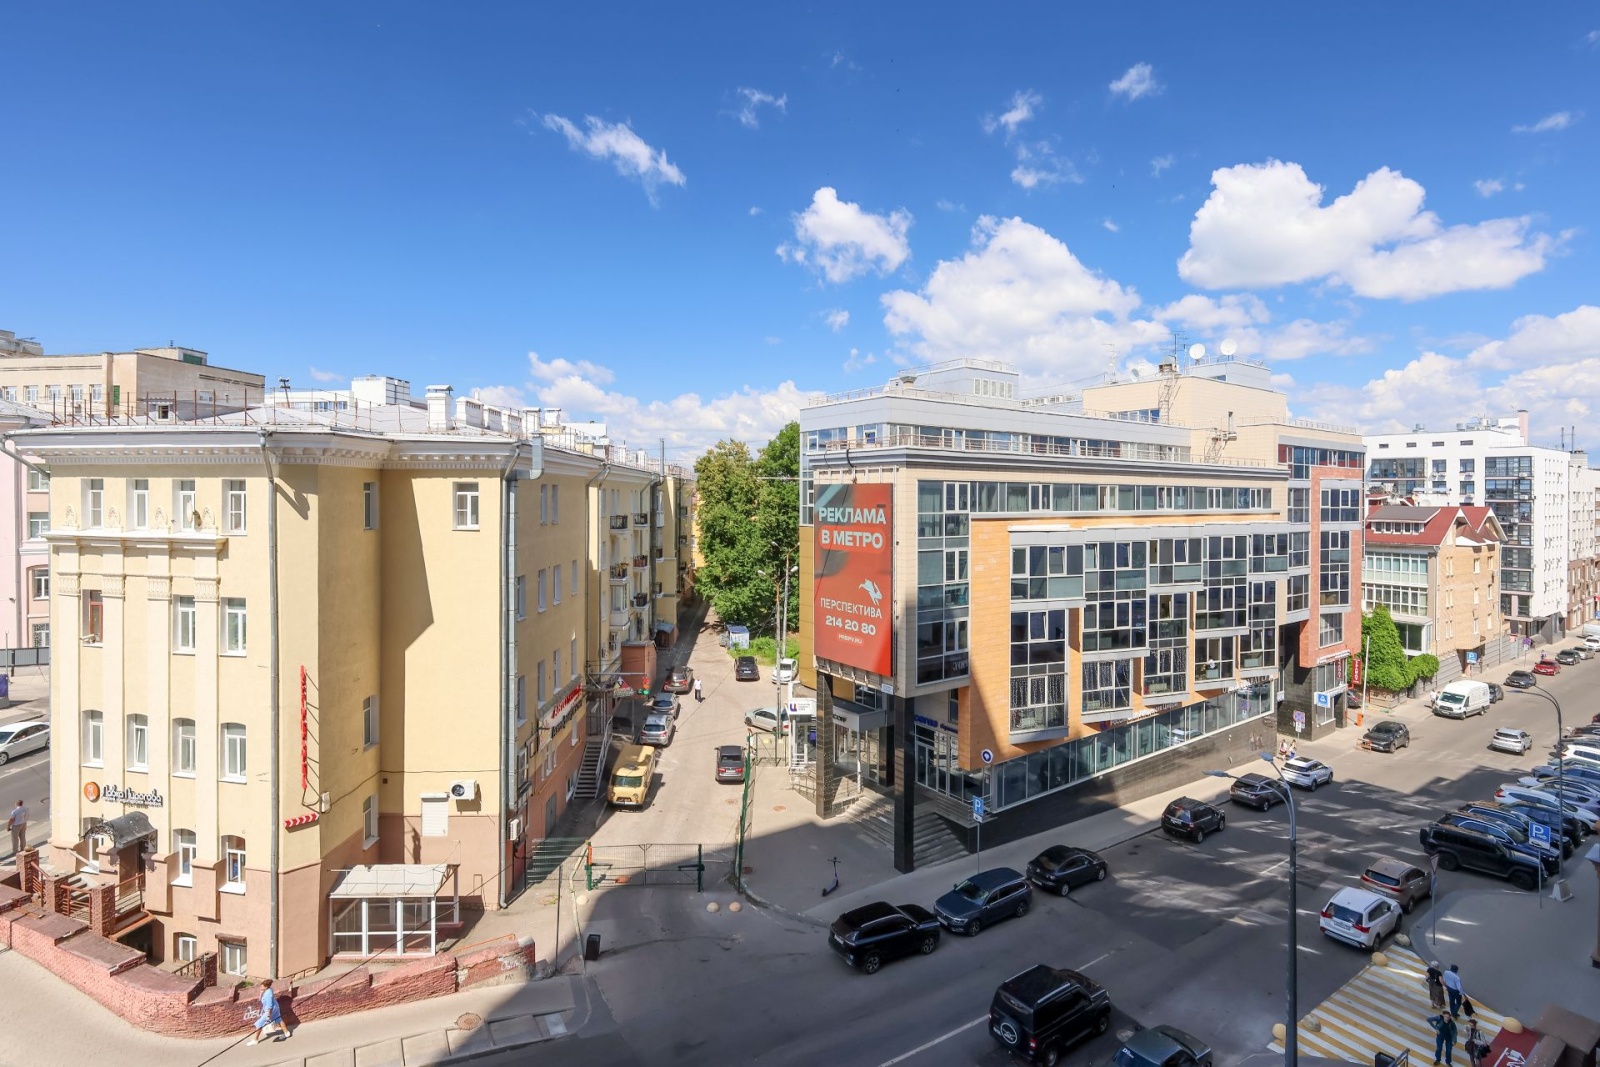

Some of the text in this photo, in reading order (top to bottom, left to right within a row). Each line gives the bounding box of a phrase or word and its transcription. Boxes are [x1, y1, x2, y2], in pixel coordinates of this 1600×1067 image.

[818, 507, 887, 525] РЕКЛАМА
[821, 529, 883, 549] В МЕТРО
[820, 597, 883, 620] ПЕРСПЕКТИВА
[825, 615, 876, 636] 214 20 80
[974, 799, 981, 811] P
[1532, 824, 1544, 837] P
